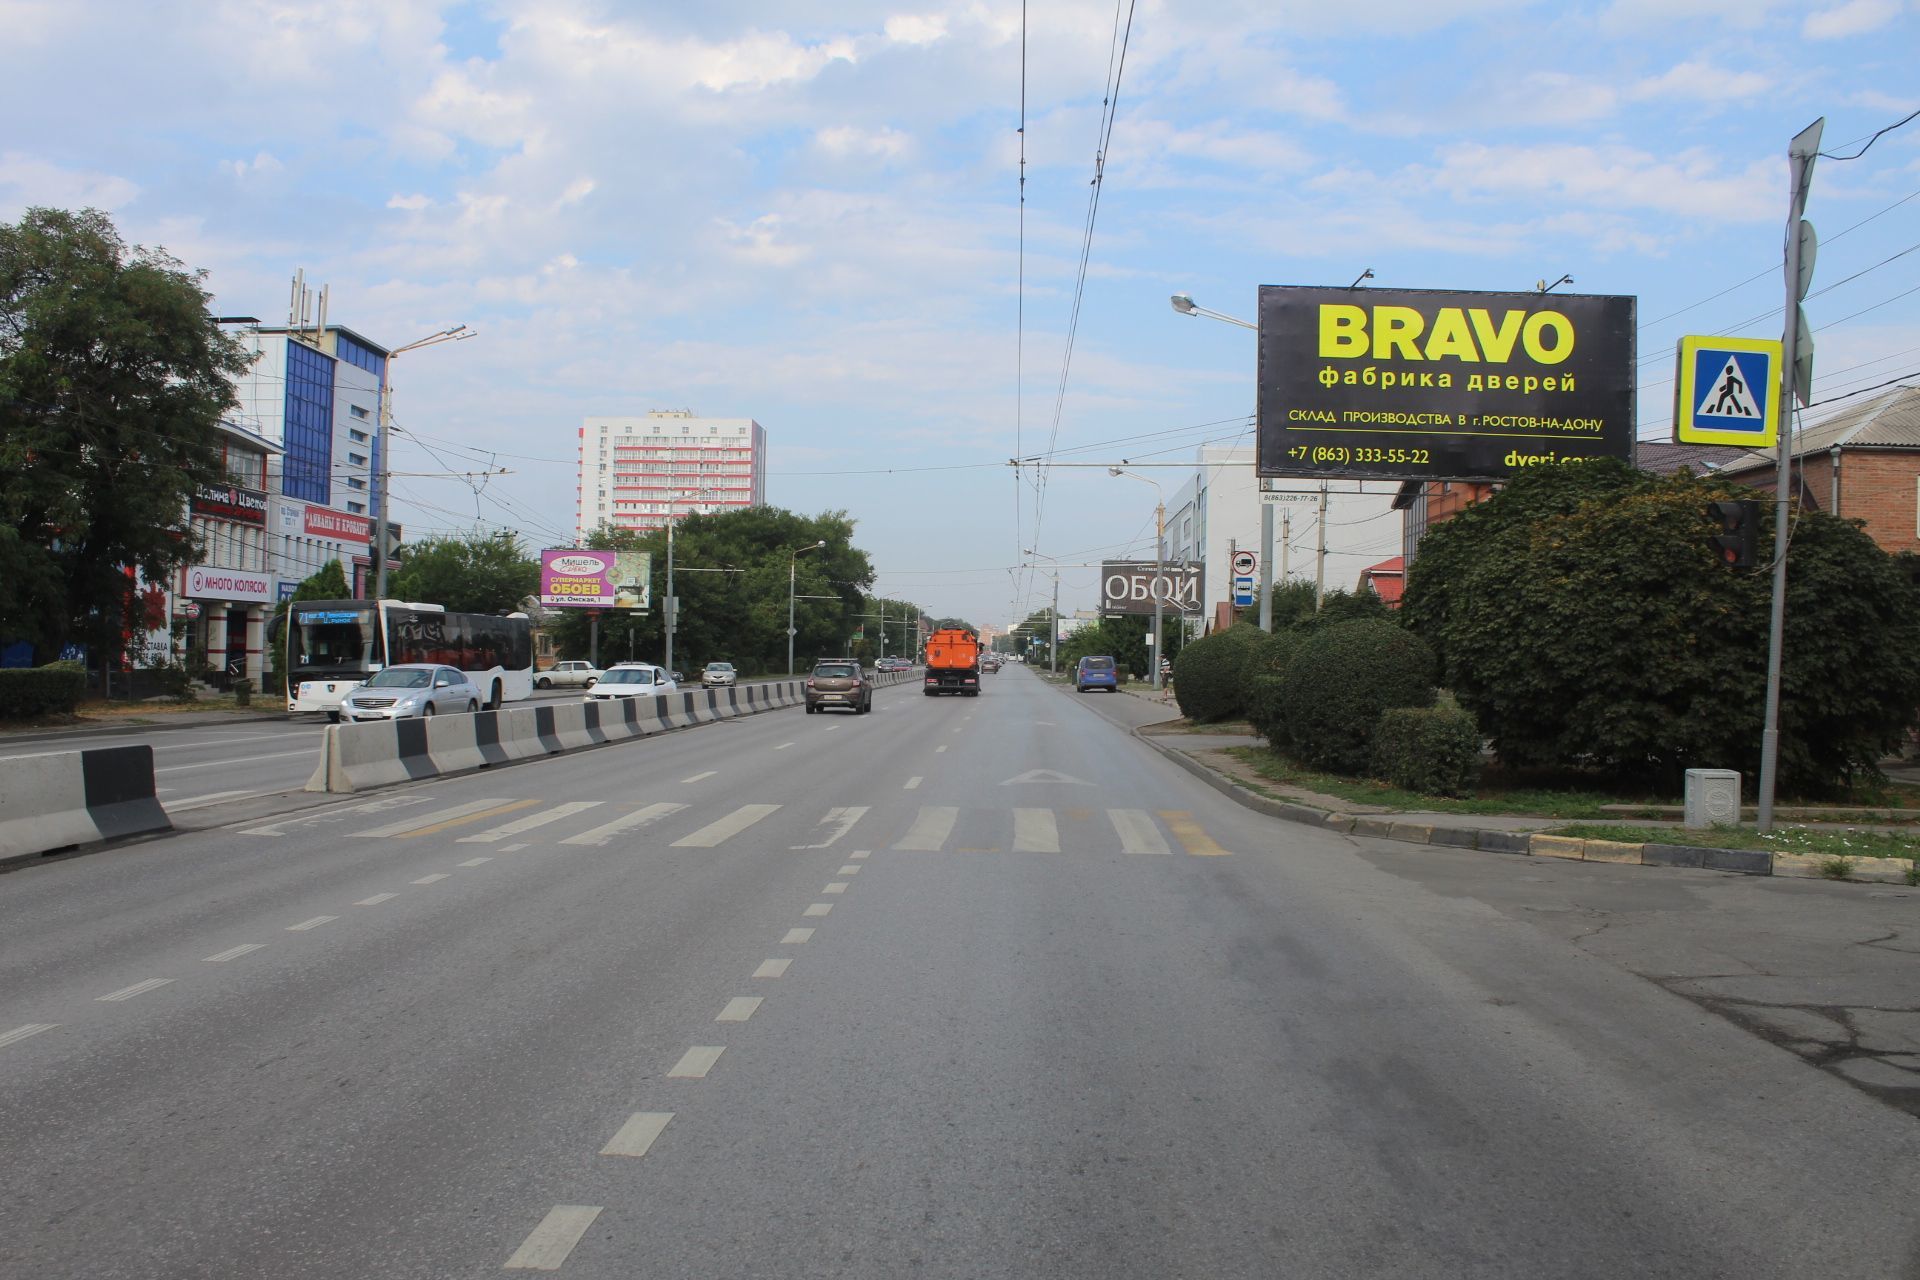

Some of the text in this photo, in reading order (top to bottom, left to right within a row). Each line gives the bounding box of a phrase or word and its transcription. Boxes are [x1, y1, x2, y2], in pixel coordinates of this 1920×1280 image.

[1319, 304, 1575, 365] BRAVO
[1319, 366, 1575, 395] фабрика дверей
[1289, 410, 1336, 423] СКЛАД
[1343, 412, 1452, 426] ПРОИЗВОДСТВА
[1458, 416, 1467, 426] В
[1287, 446, 1430, 465] +7 (863) 333-55-22
[561, 558, 600, 567] Мишель
[205, 577, 267, 593] МНОГО КОЛЯСОК
[550, 584, 601, 594] ОБОЕВ
[1105, 574, 1199, 604] ОБОИ
